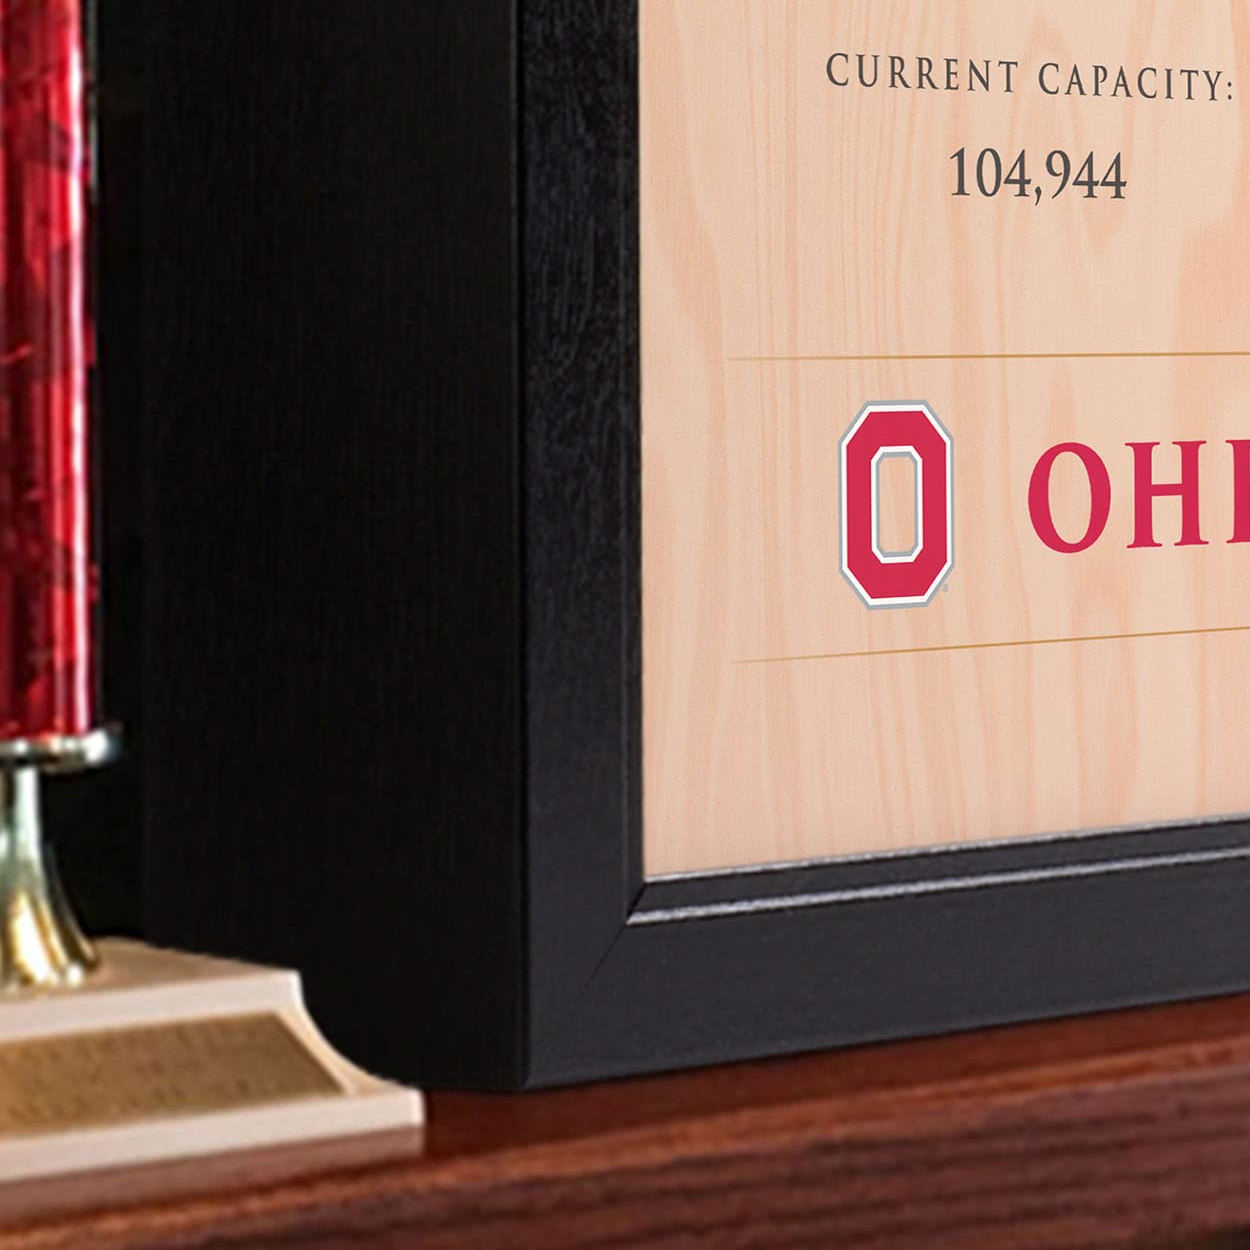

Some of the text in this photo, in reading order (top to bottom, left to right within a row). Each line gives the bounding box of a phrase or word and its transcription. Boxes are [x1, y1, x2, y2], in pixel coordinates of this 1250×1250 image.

[826, 52, 1233, 101] CURRENT CAPACITY:
[949, 146, 1127, 205] 104,944
